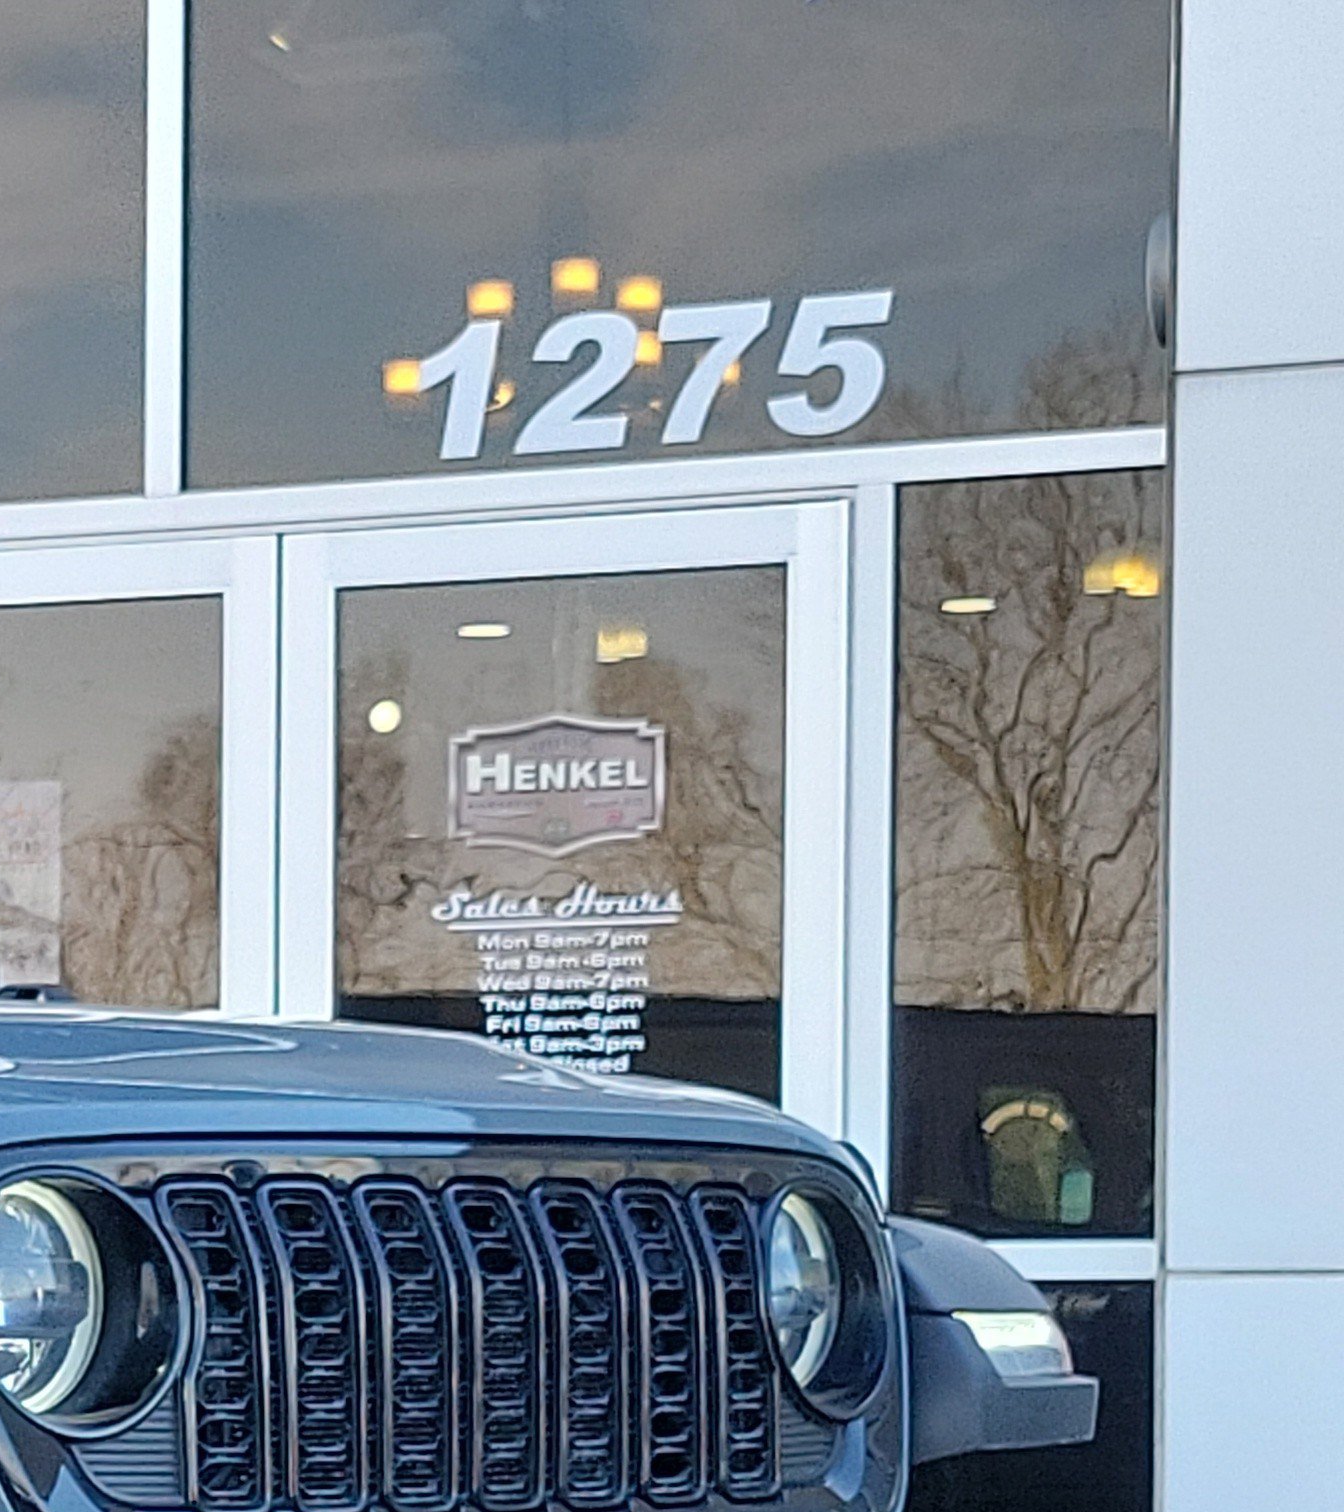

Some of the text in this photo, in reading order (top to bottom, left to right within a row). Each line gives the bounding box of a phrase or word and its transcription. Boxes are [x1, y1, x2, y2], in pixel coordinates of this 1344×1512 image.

[418, 290, 894, 460] 1275
[466, 752, 649, 794] HENKEL
[431, 884, 684, 921] Sales Hours
[477, 932, 529, 950] Mon
[482, 956, 522, 972] Tue
[477, 975, 531, 992] Wed
[479, 995, 527, 1013] Thu
[486, 1016, 522, 1034] Fri
